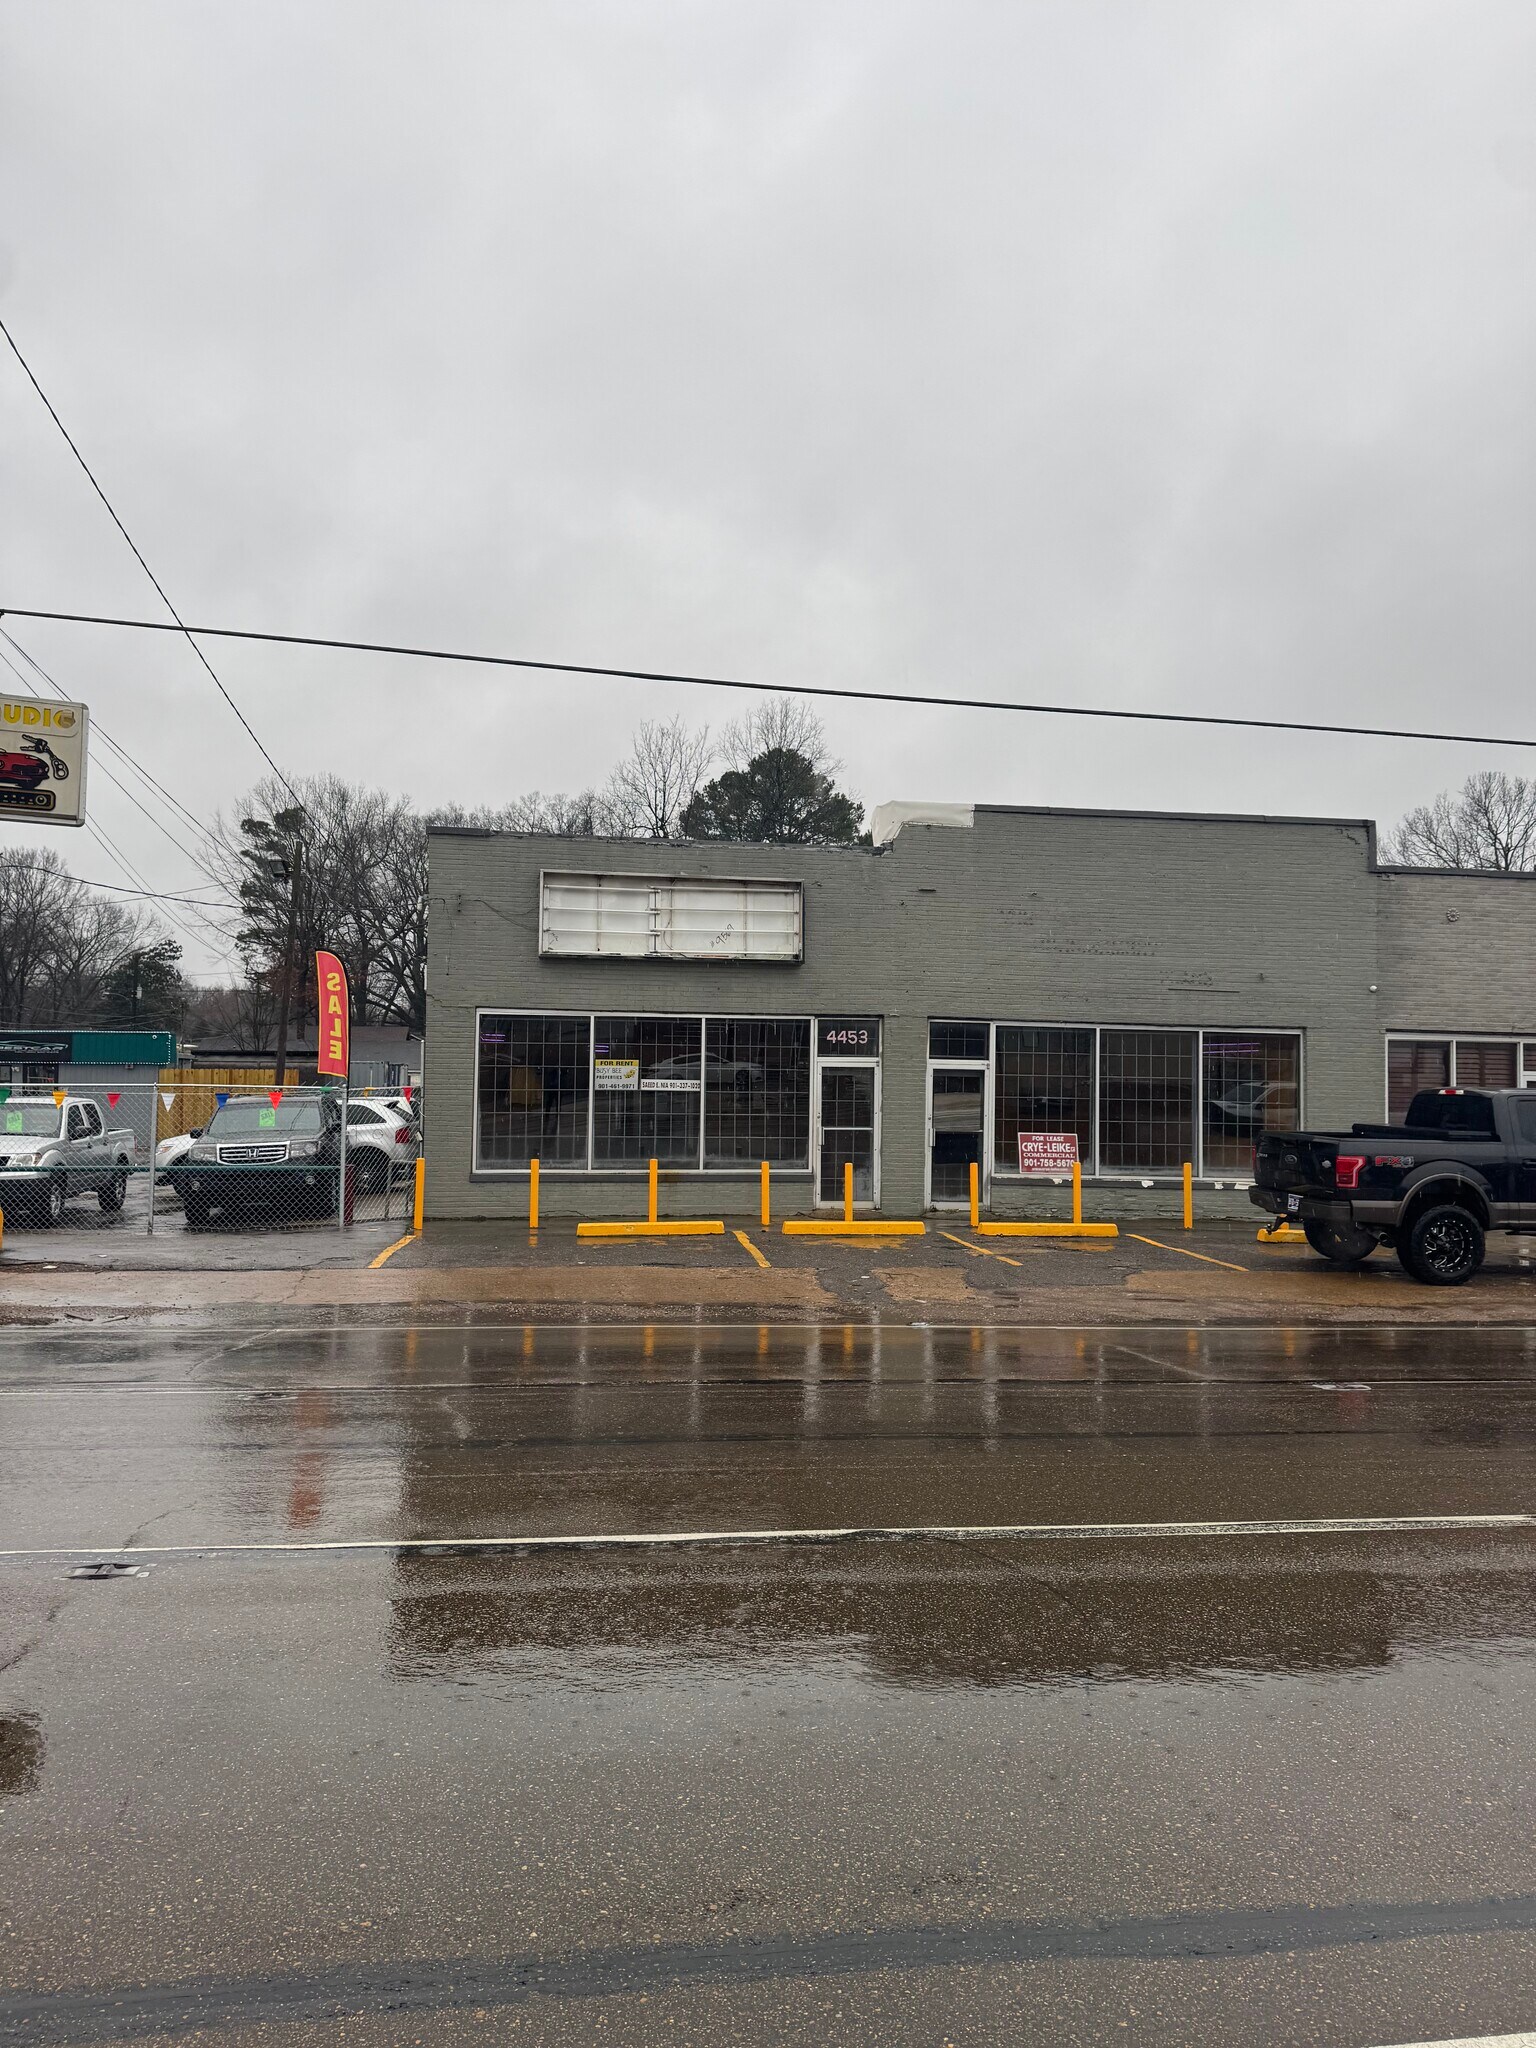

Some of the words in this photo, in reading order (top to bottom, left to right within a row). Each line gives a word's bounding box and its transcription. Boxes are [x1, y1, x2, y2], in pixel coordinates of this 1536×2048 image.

[0, 704, 76, 728] UDIO
[826, 1030, 868, 1044] 4453
[1021, 1142, 1071, 1152] CRYE-LEIKE
[1375, 1155, 1414, 1167] FX4
